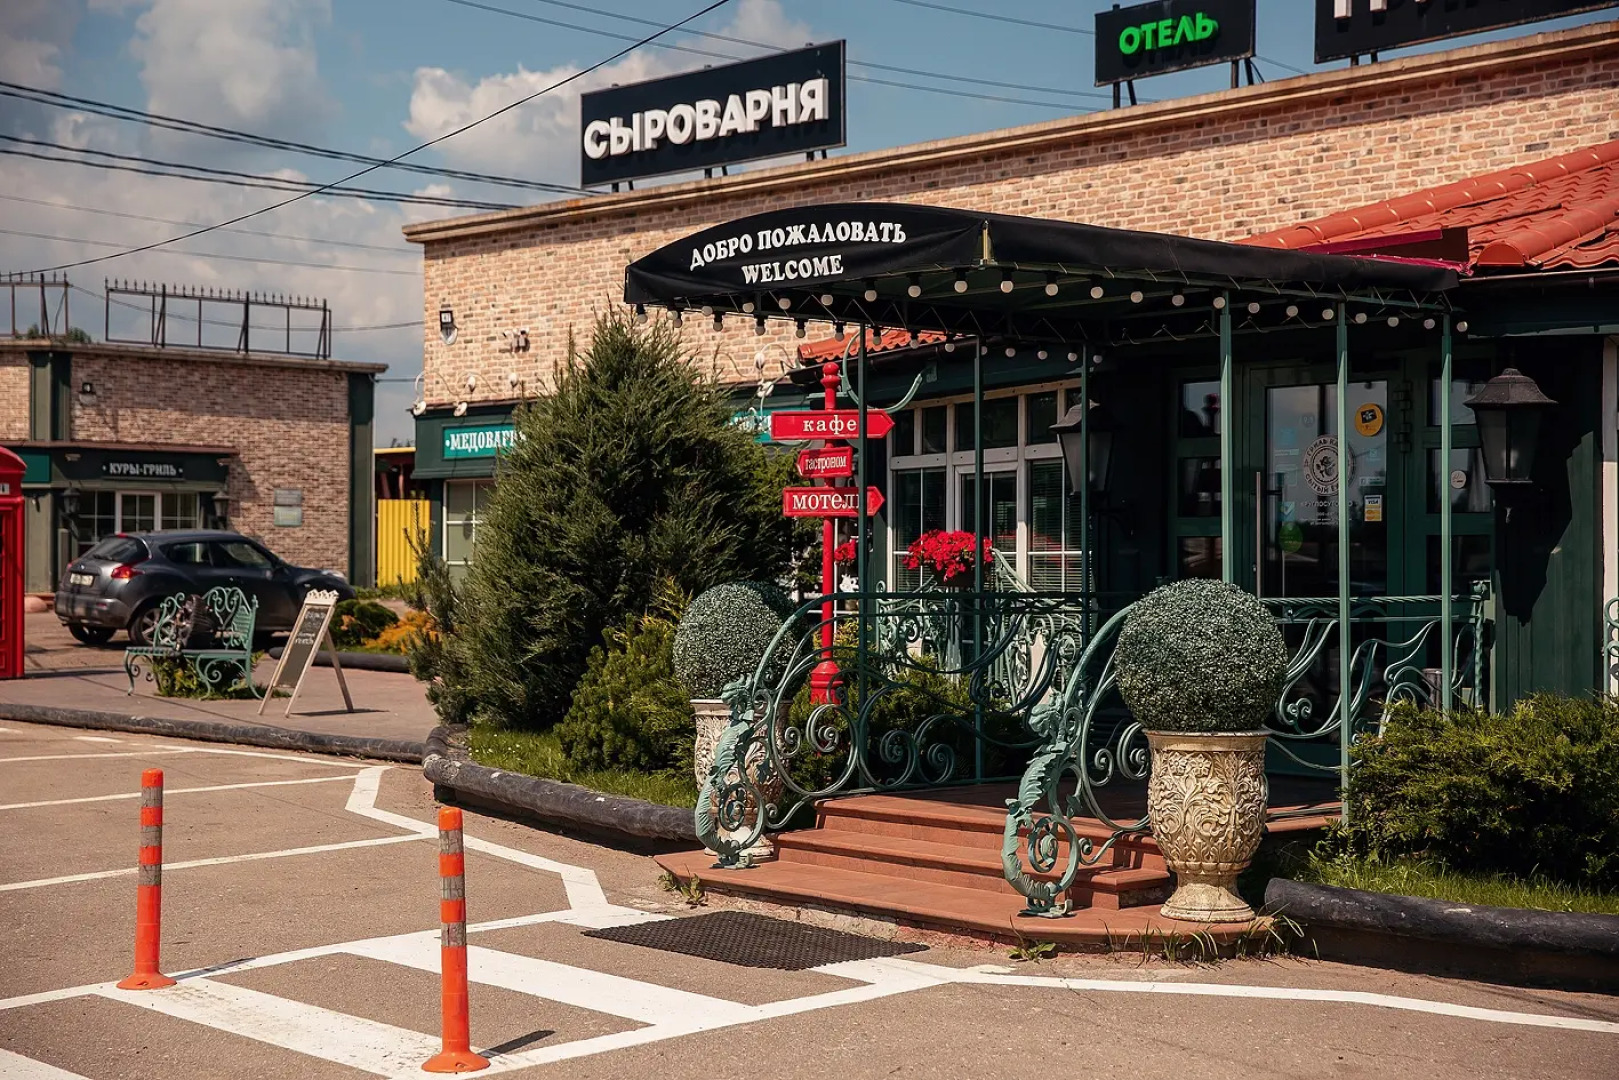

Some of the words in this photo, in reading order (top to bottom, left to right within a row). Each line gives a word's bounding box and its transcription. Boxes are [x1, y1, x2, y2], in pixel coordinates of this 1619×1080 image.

[1118, 12, 1217, 55] ОТЕЛЬ
[583, 78, 829, 159] СЫРОВАРНЯ
[689, 233, 753, 271] ДОБРО
[757, 221, 907, 251] ПОЖАЛОВАТЬ
[740, 254, 844, 284] WELCOME
[802, 414, 858, 435] кафе
[109, 462, 177, 477] КУРЫ-ГРИЛЬ
[805, 456, 847, 473] гастроном
[792, 493, 860, 511] мотел
